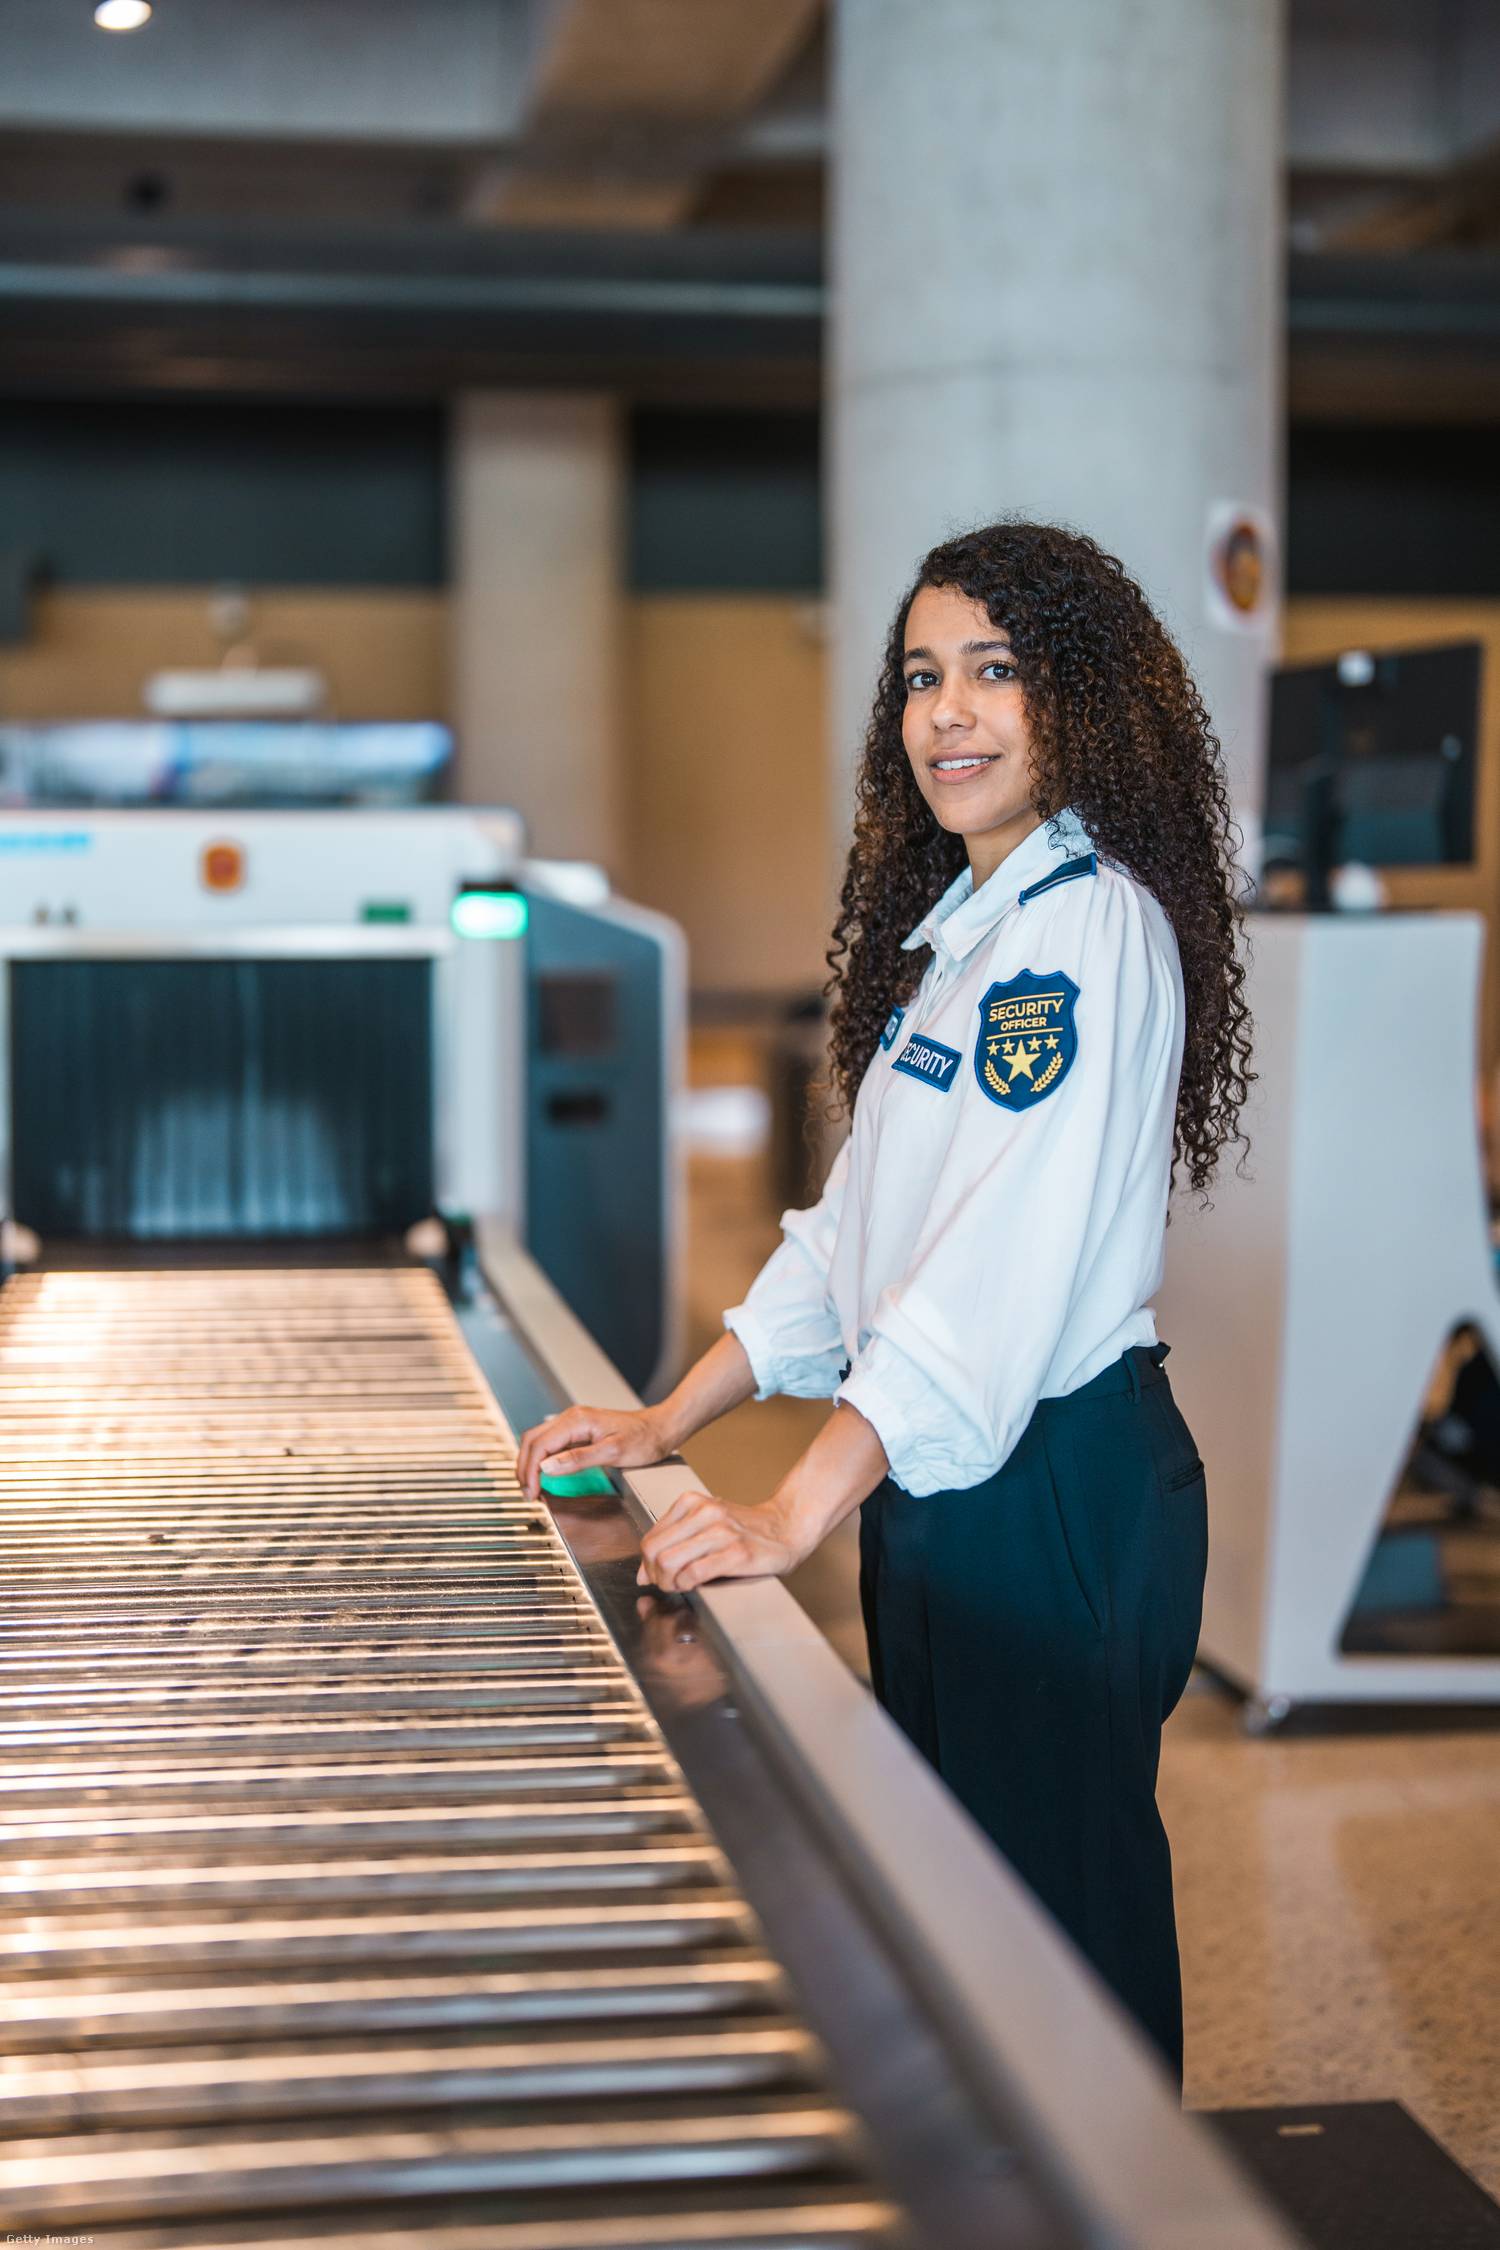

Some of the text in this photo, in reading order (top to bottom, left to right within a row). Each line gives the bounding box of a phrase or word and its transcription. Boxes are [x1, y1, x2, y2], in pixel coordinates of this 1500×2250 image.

[989, 999, 1064, 1023] SECURITY
[1000, 1016, 1047, 1032] OFFICER
[900, 1042, 954, 1078] ECURITY
